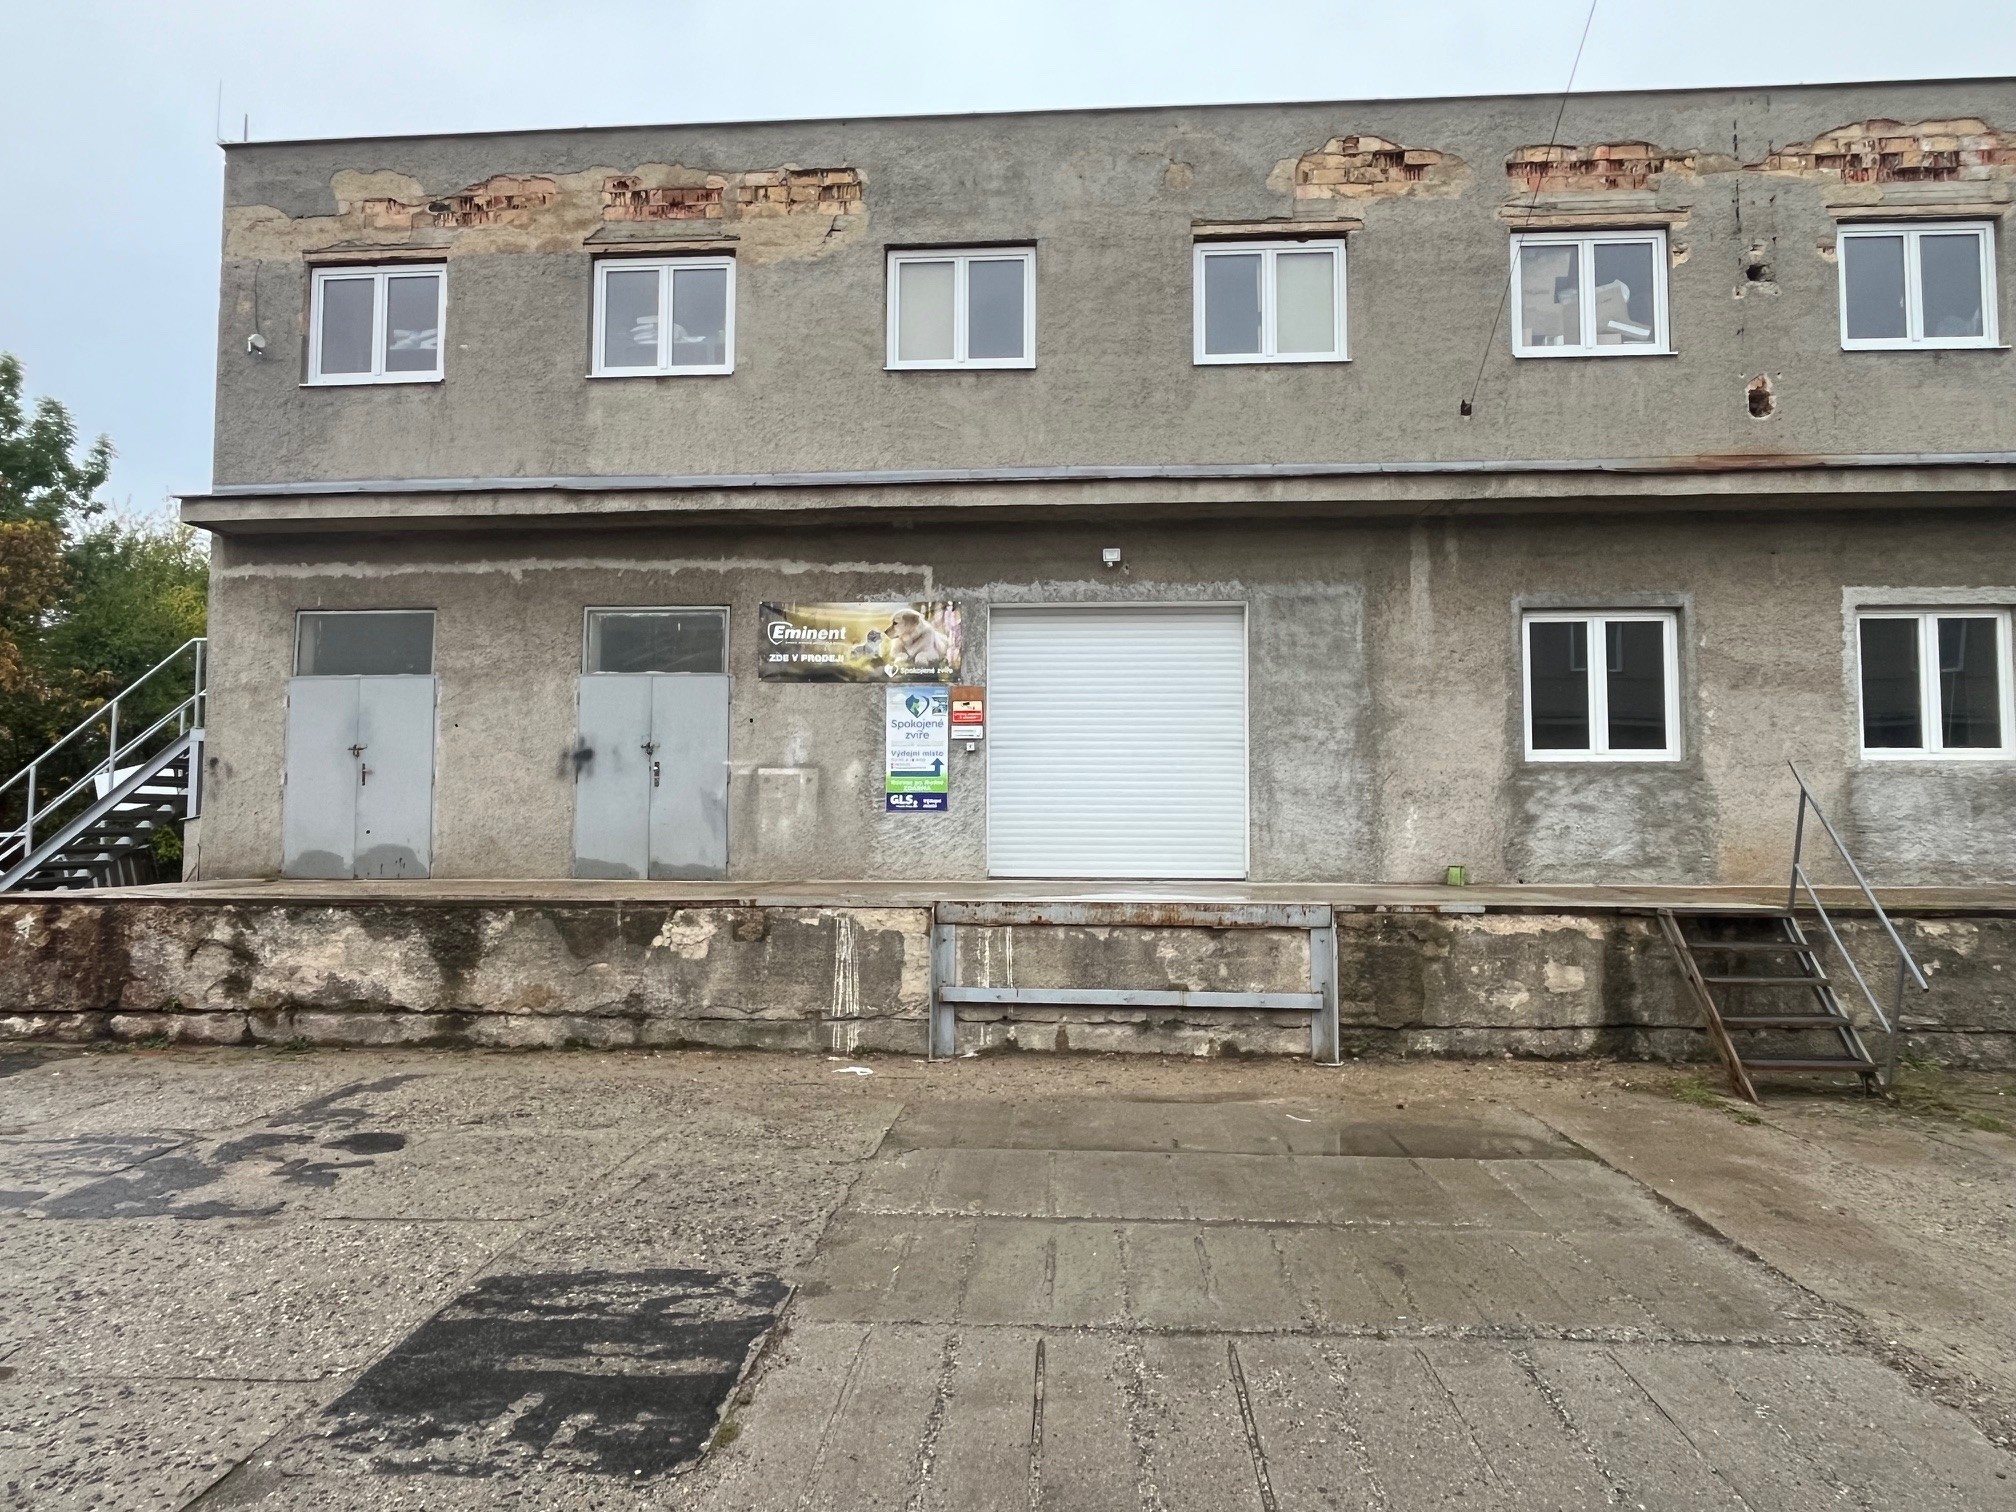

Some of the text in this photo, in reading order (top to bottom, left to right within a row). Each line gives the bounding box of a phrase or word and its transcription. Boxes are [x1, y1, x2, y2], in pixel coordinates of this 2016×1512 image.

[772, 624, 847, 640] Eminent
[768, 653, 789, 663] ZDE
[792, 653, 799, 663] V
[891, 718, 944, 730] Spokojené
[905, 729, 930, 739] zvíře
[890, 794, 914, 805] GLS
